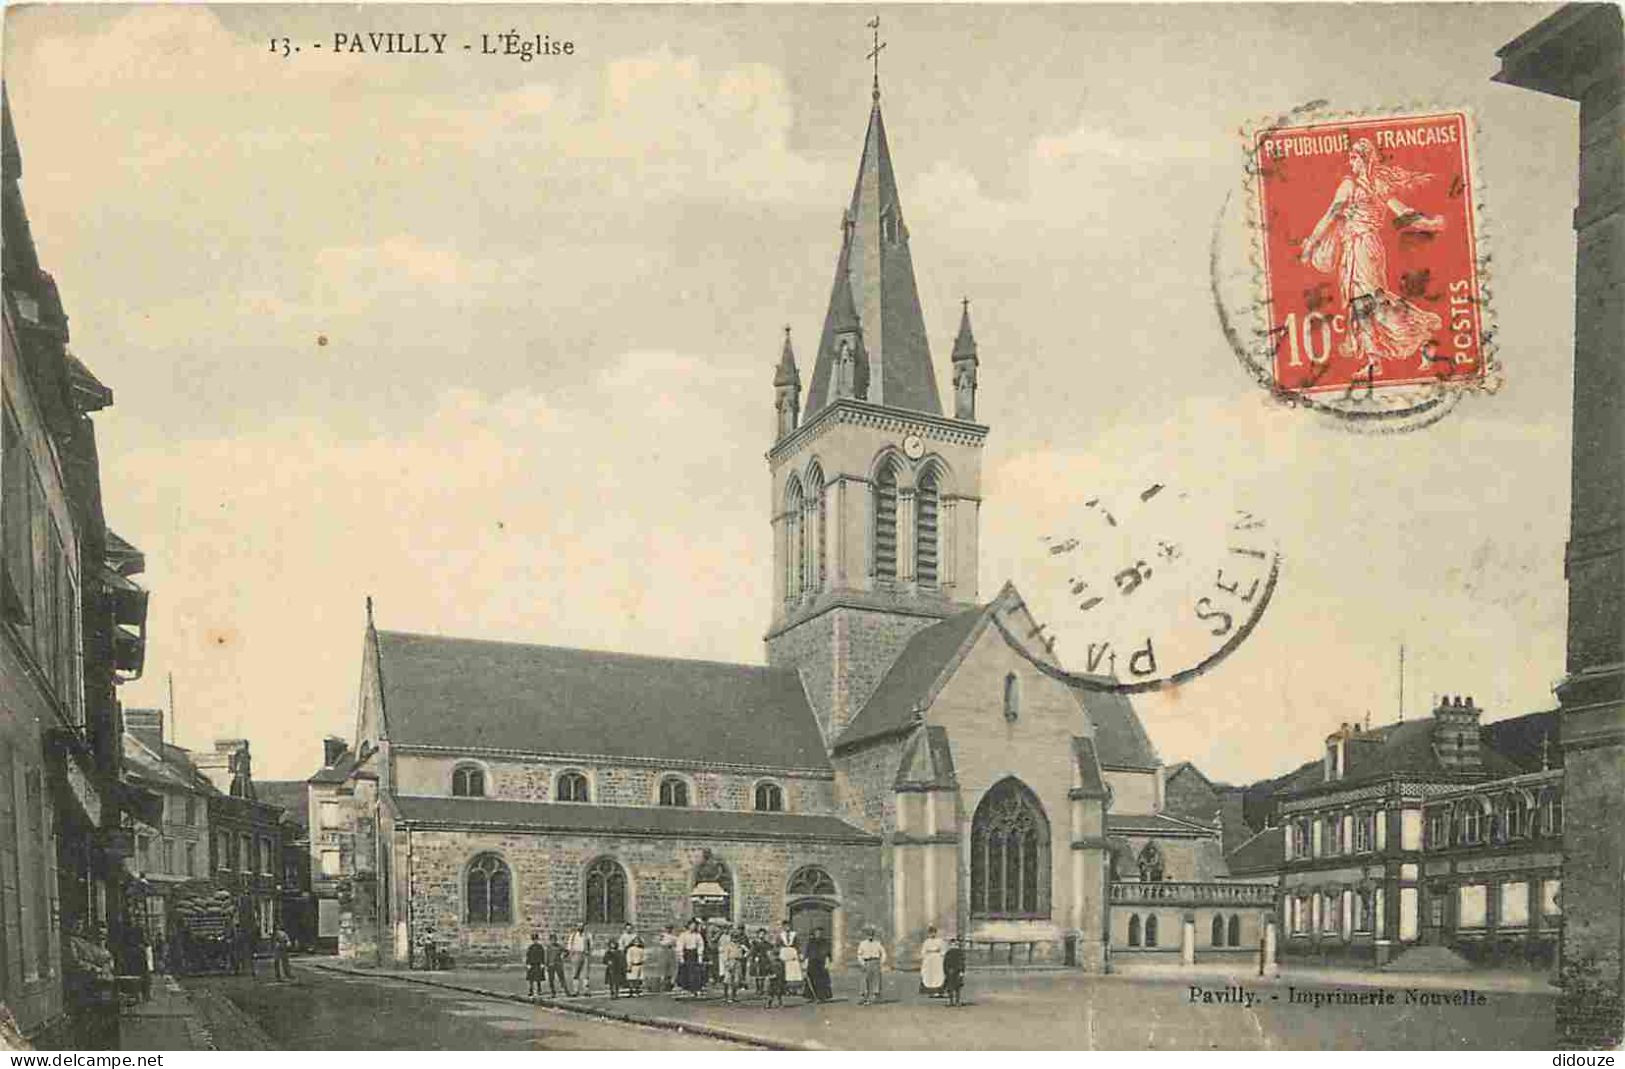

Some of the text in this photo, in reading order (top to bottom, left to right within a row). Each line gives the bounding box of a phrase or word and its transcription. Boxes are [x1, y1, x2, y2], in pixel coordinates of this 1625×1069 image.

[269, 37, 301, 58] 13.
[333, 32, 448, 54] PAVILLY
[481, 28, 575, 62] L'Église
[1449, 280, 1473, 364] POSTES
[1288, 986, 1396, 1009] Imprimerie
[1405, 988, 1488, 1006] Nouvelle
